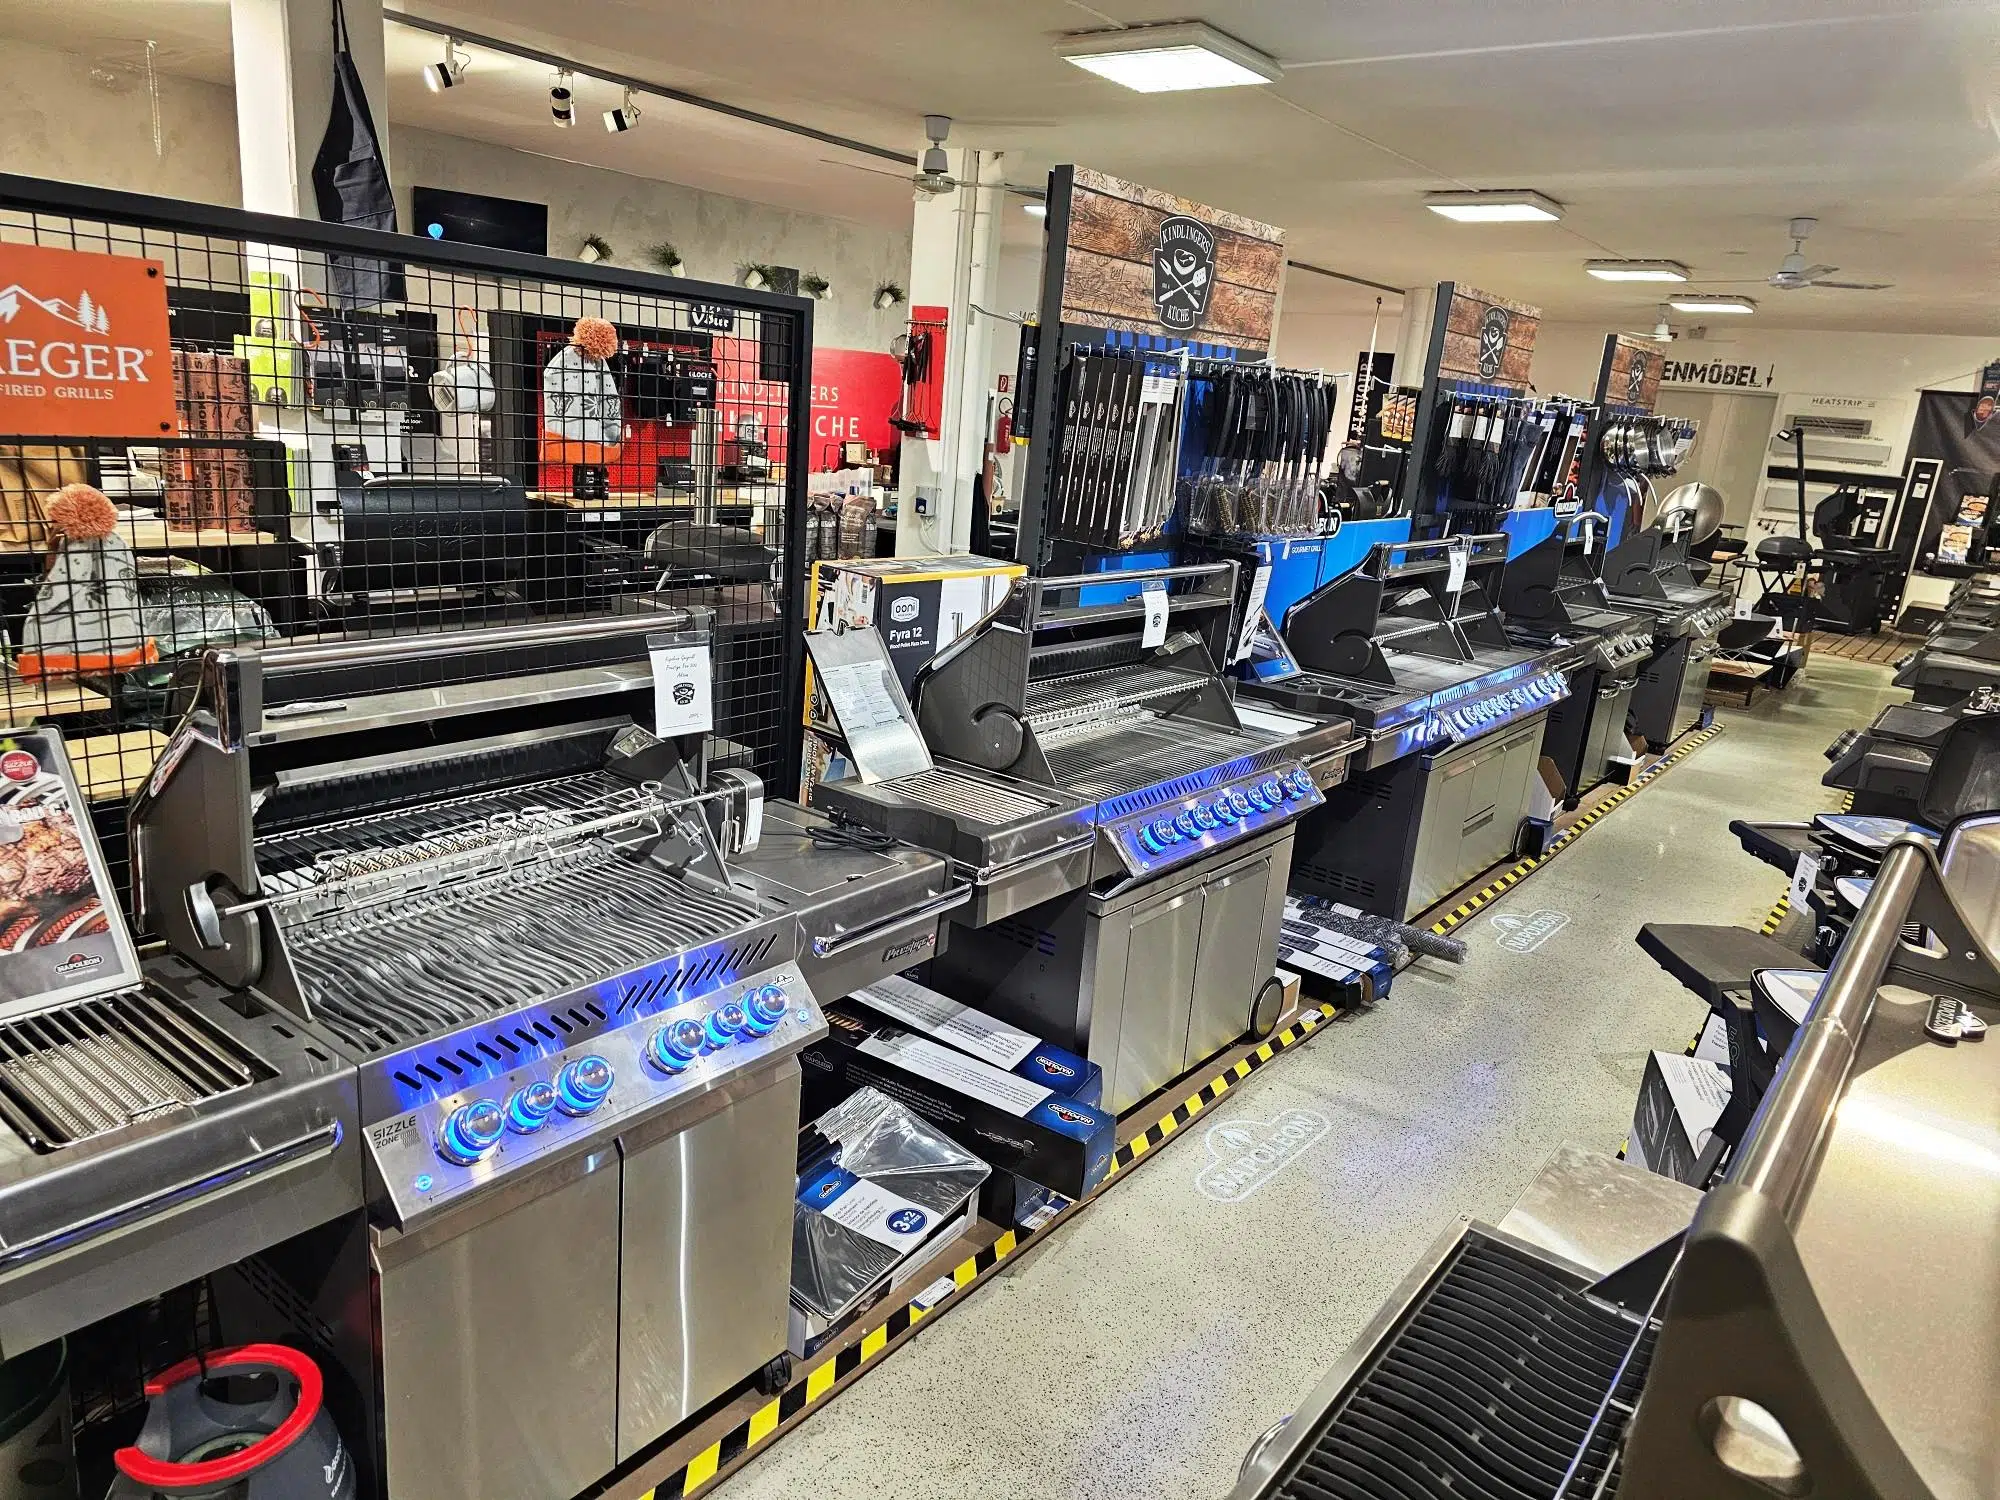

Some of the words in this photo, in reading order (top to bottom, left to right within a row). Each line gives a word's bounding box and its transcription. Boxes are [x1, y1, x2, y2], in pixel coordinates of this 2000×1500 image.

[1162, 225, 1211, 254] KINDLINGERS
[1167, 304, 1190, 322] KÜCHE
[0, 338, 149, 382] EGER
[1661, 358, 1760, 387] ENMÖBEL
[54, 386, 114, 400] GRILLS
[718, 380, 839, 402] KINDLIERS
[1811, 397, 1862, 407] HEATSTRIP
[203, 462, 214, 511] SMOKE
[896, 602, 916, 613] ooni
[890, 630, 910, 642] Fyra
[912, 627, 922, 638] 12
[57, 957, 100, 972] NAPOLEON
[805, 1054, 831, 1070] NAPOLEON
[1039, 1057, 1072, 1075] NAPOLEON
[1051, 1105, 1091, 1124] NAPOLEON
[373, 1115, 416, 1141] SIZZLE
[376, 1134, 399, 1149] ZONE
[1208, 1114, 1318, 1194] NAPOLEON
